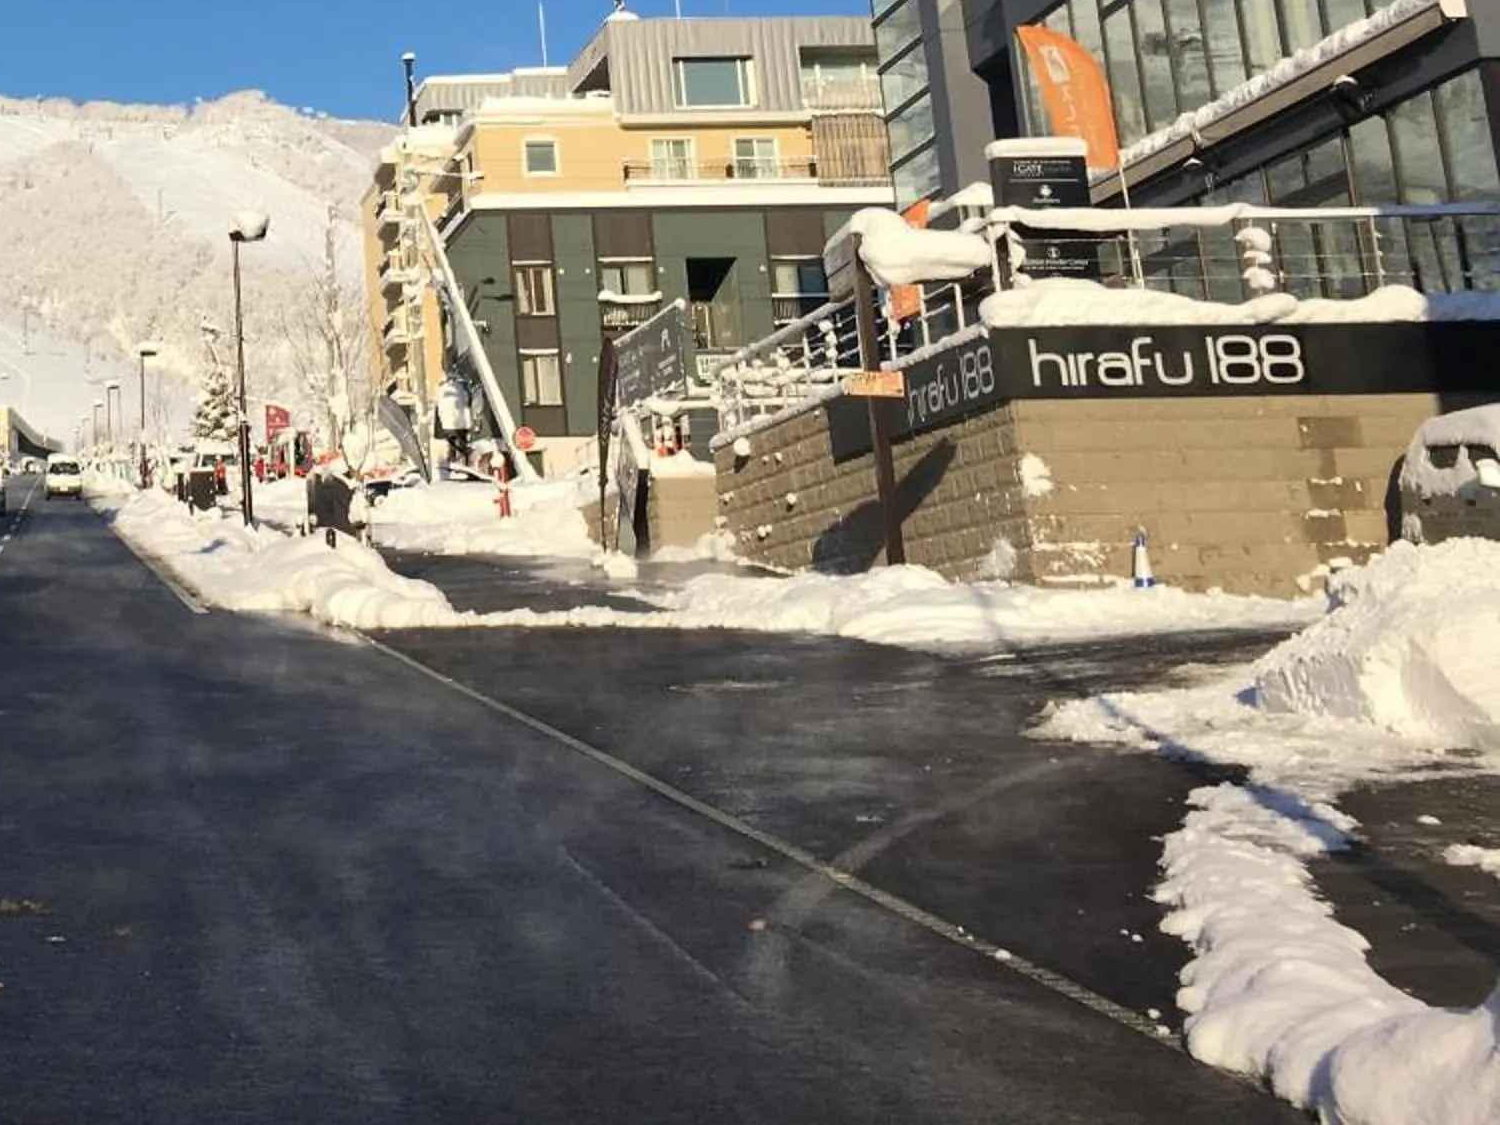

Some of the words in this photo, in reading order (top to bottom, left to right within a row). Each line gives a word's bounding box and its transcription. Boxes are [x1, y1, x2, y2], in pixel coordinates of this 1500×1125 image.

[907, 363, 959, 427] hirafu
[956, 345, 995, 401] 188
[1028, 337, 1194, 387] hirafu
[1205, 334, 1304, 385] 188
